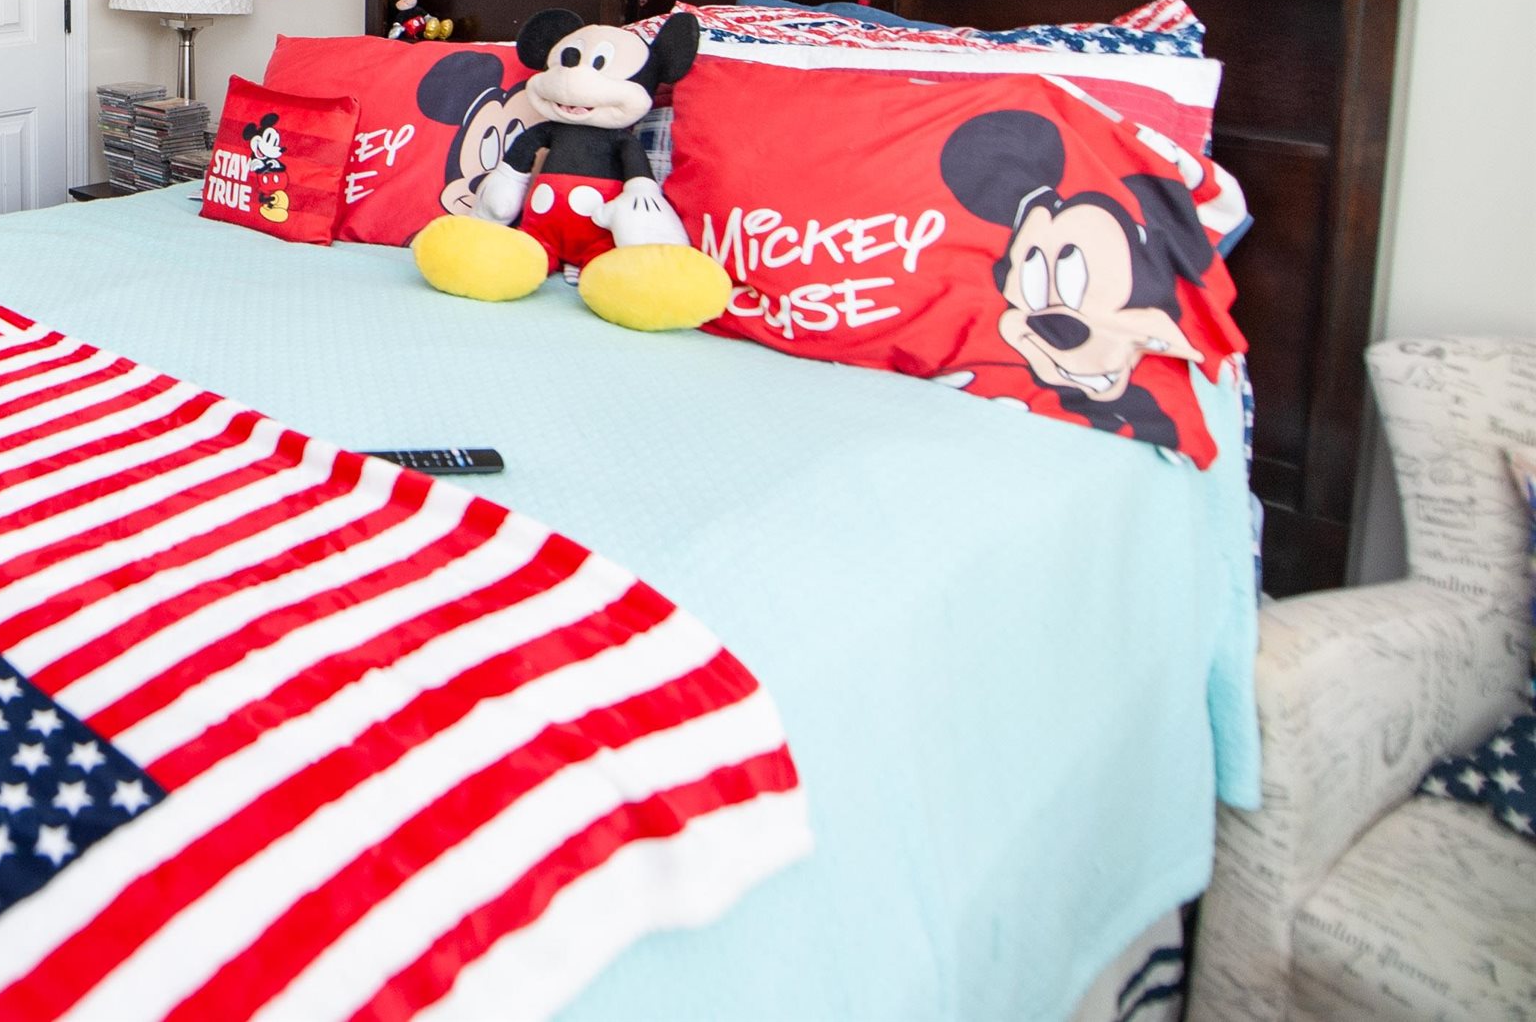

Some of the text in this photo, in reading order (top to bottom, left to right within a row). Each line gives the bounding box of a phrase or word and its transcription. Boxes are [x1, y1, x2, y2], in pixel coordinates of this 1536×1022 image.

[214, 149, 251, 180] STAY
[206, 175, 252, 212] TRUE
[726, 277, 901, 340] OUSE
